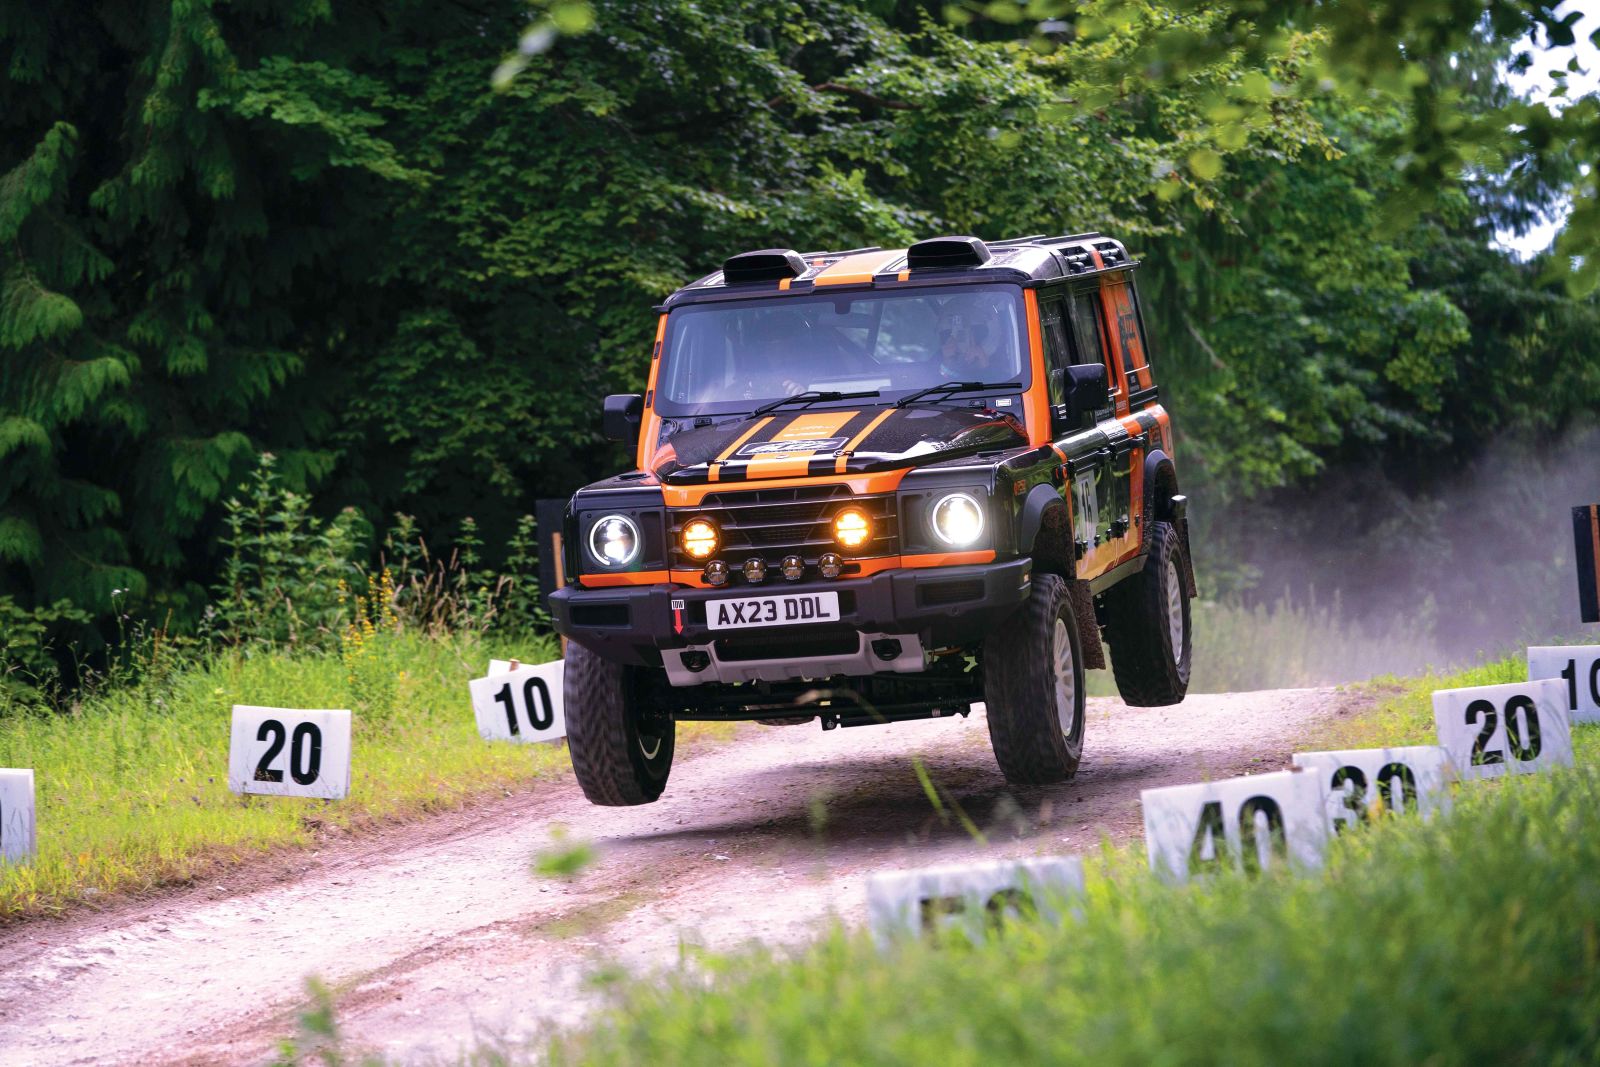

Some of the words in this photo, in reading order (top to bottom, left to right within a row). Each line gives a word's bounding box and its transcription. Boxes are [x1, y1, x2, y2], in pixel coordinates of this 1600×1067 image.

[717, 600, 777, 625] AX23
[784, 597, 830, 620] DDL
[494, 677, 554, 736] 10
[1465, 694, 1541, 767] 20
[254, 719, 322, 785] 20
[1188, 795, 1287, 879] 40
